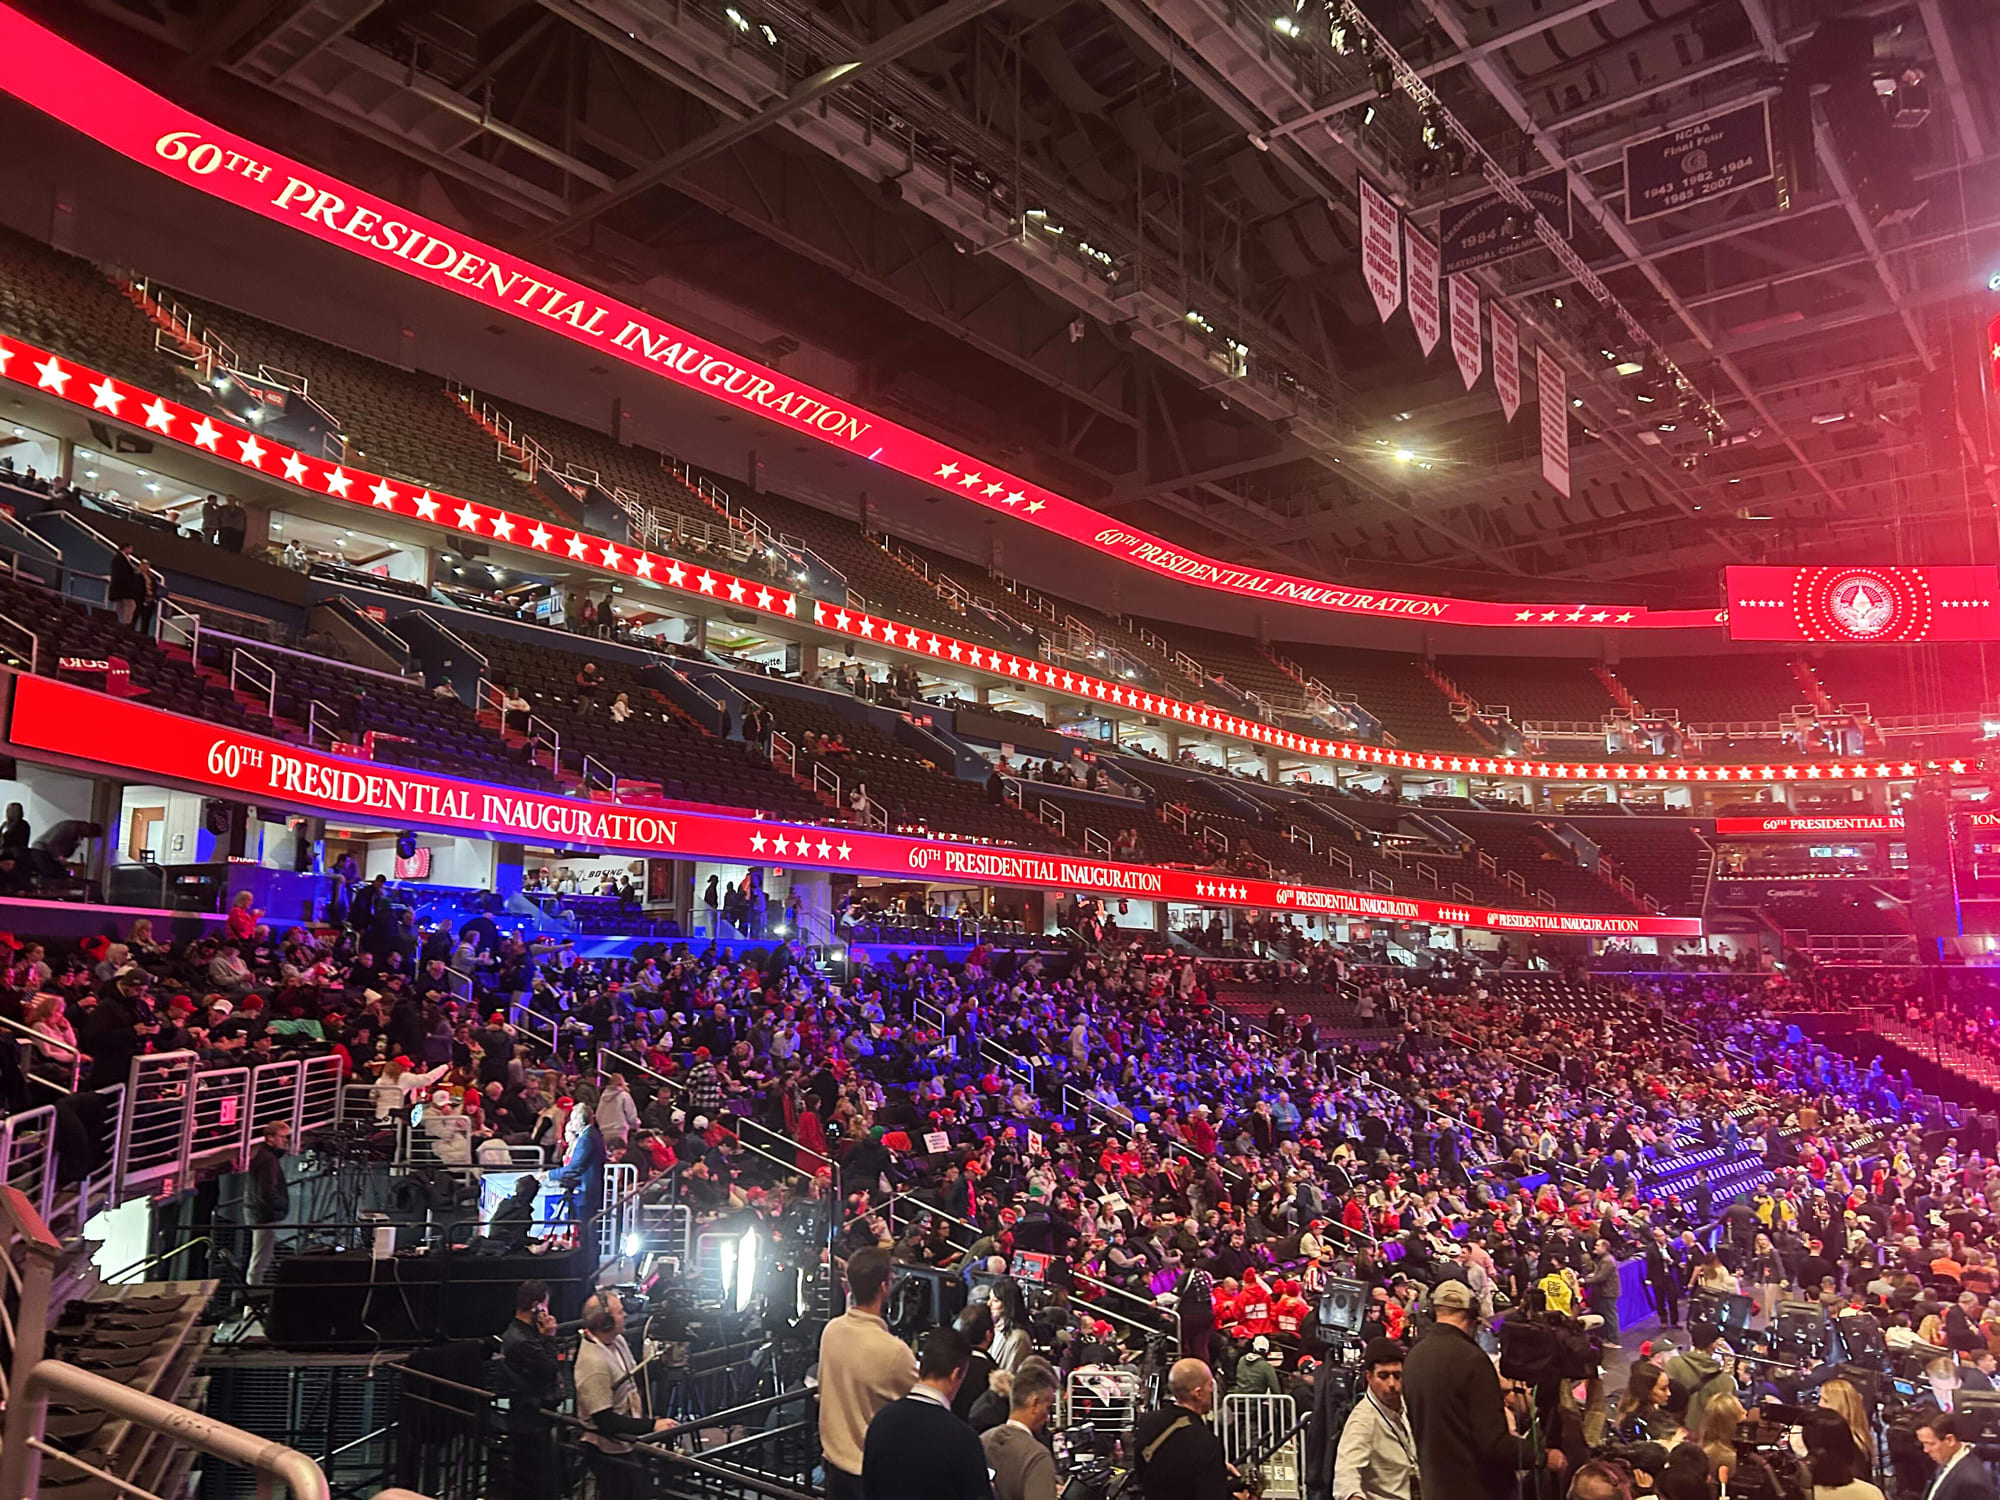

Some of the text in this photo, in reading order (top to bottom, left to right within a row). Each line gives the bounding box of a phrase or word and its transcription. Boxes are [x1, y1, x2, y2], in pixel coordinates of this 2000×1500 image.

[1675, 123, 1711, 141] NCAA
[1664, 141, 1693, 158] Final
[1702, 175, 1734, 194] 2007
[155, 132, 872, 441] 60TH PRESIDENTIAL INAUGURATION
[1095, 528, 1450, 616] 60TH PRESIDENTIAL INAUGURATION
[208, 740, 677, 845] 60TH PRESIDENTIAL INAUGURATION
[1763, 819, 1787, 830] 60TH
[1790, 818, 1885, 830] PRESIDENTIAL
[908, 847, 1161, 892] 60TH PRESIDENTIAL INAUGURATION
[1276, 888, 1419, 917] 60TH PRESIDENTIAL INAUGURATION
[1499, 913, 1560, 929] PRESIDENTIAL
[1561, 919, 1638, 931] INAUGURATION
